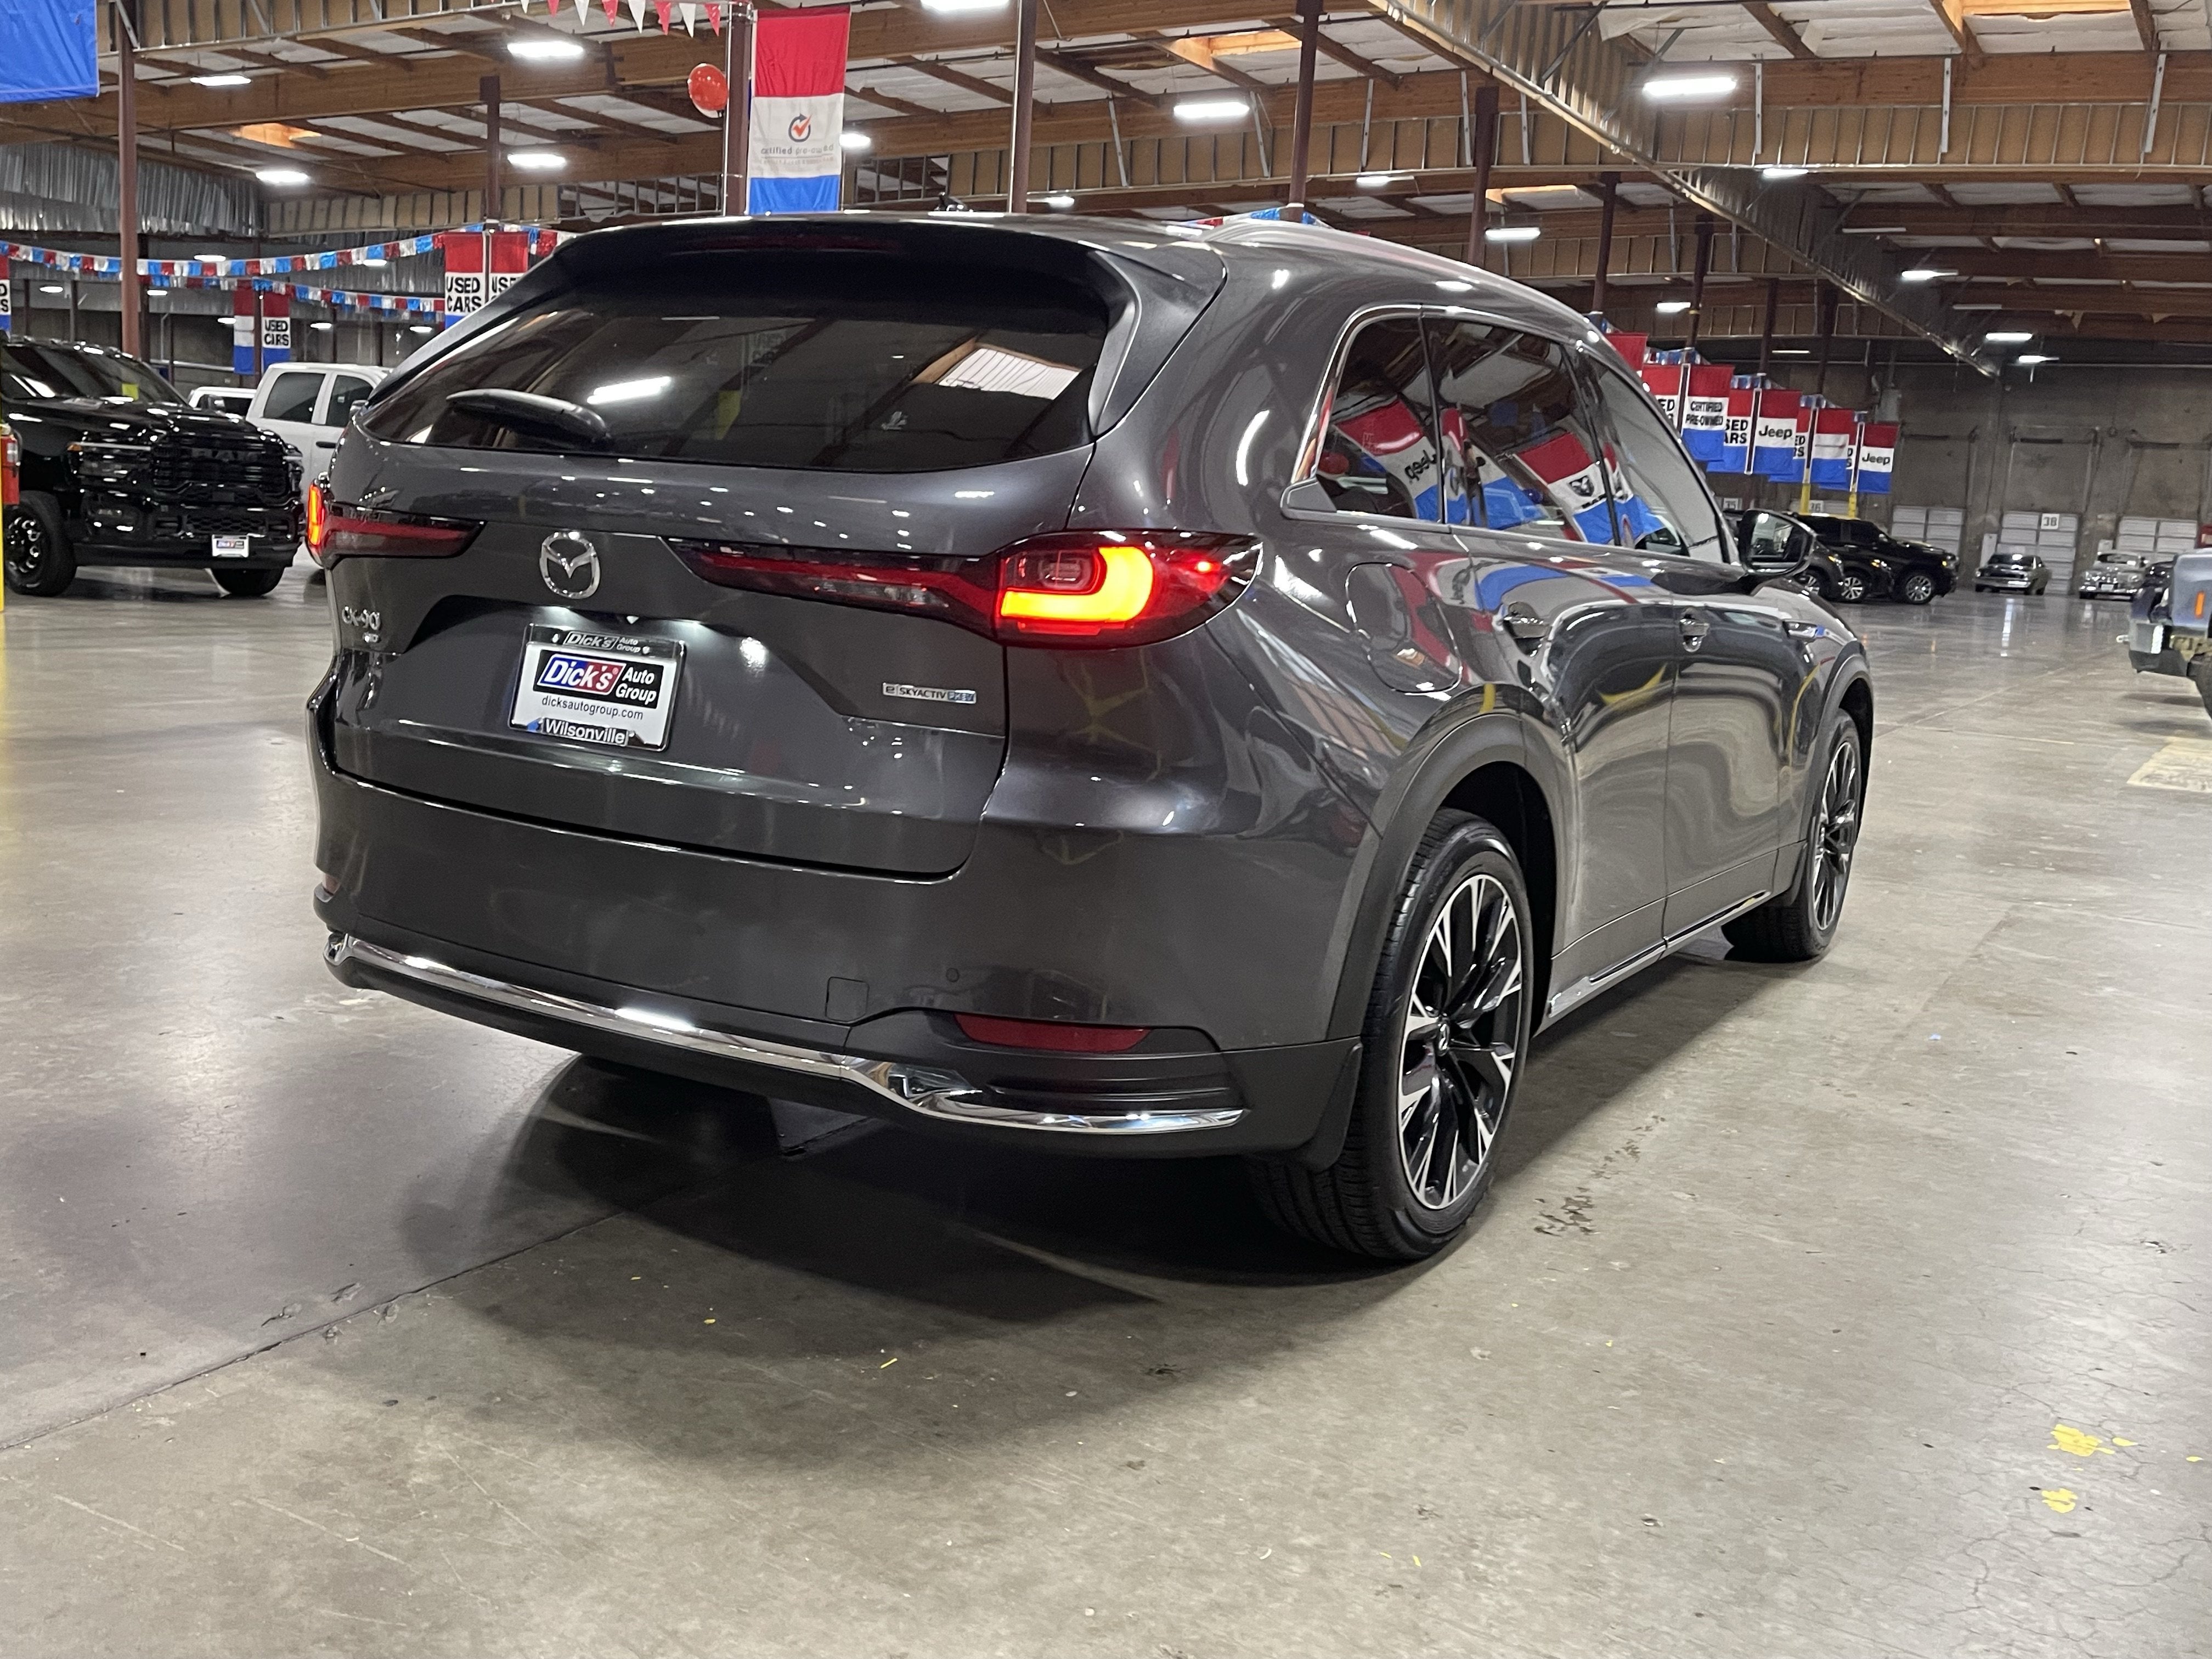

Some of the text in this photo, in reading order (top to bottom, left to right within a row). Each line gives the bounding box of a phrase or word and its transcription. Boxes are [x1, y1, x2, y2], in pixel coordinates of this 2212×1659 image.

[446, 276, 481, 294] USED
[447, 295, 481, 313] CARS
[264, 319, 288, 332] USED
[1758, 425, 1793, 439] Jeep
[1861, 453, 1891, 465] Jeep
[616, 643, 641, 653] Group
[619, 636, 639, 645] Auto
[544, 660, 613, 690] Dick's
[622, 667, 655, 685] Auto
[615, 684, 657, 706] Group
[899, 687, 947, 699] SKYACTIV
[541, 695, 644, 720] dicksautogroup.com
[545, 719, 625, 744] Wilsonville
